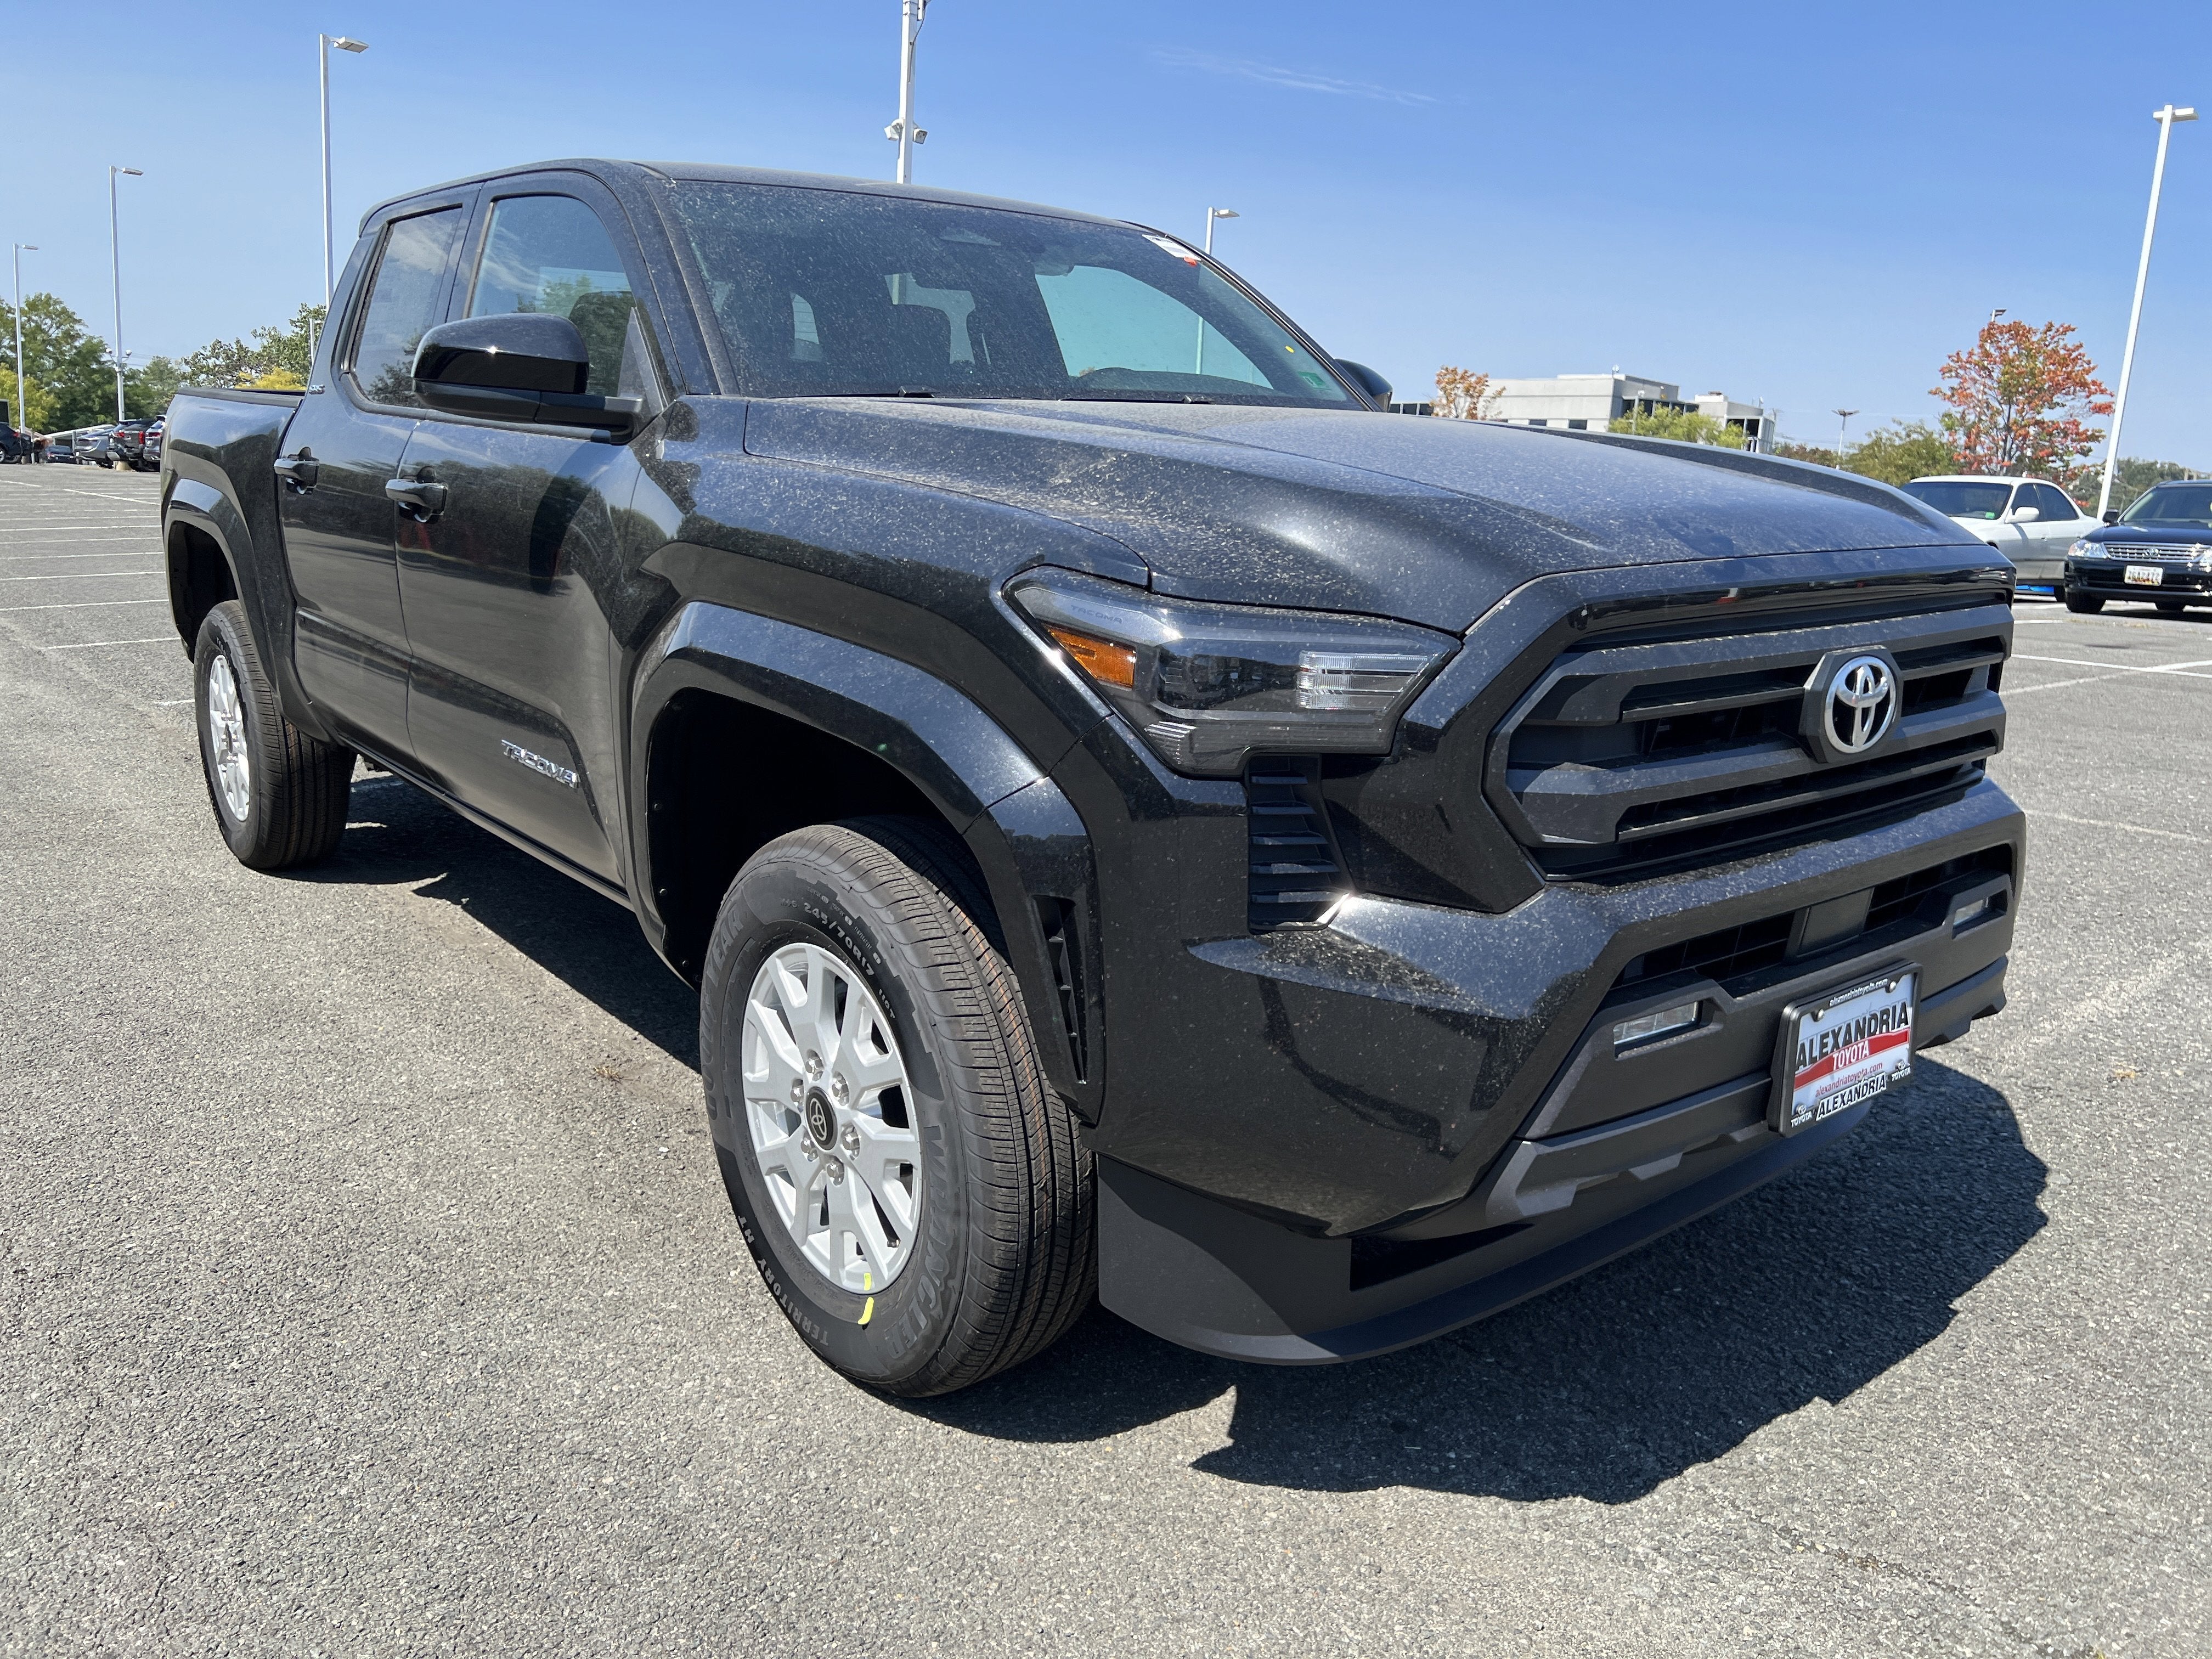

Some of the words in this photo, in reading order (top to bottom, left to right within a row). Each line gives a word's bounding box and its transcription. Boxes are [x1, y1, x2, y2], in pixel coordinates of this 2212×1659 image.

[1071, 605, 1122, 624] TACOMA
[501, 739, 580, 788] TACOMA
[804, 902, 875, 976] 245/70R17
[1796, 1001, 1909, 1069] ALEXANDRIA
[1832, 1040, 1870, 1070] TOYOTA
[1791, 1110, 1813, 1128] TOYOTA
[1817, 1074, 1887, 1120] ALEXANDRIA
[1892, 1066, 1911, 1082] TOYOTA
[1815, 1062, 1883, 1097] alexandriatoyota.com
[883, 1125, 947, 1359] WRANGLER
[757, 1258, 828, 1346] TERRITORY
